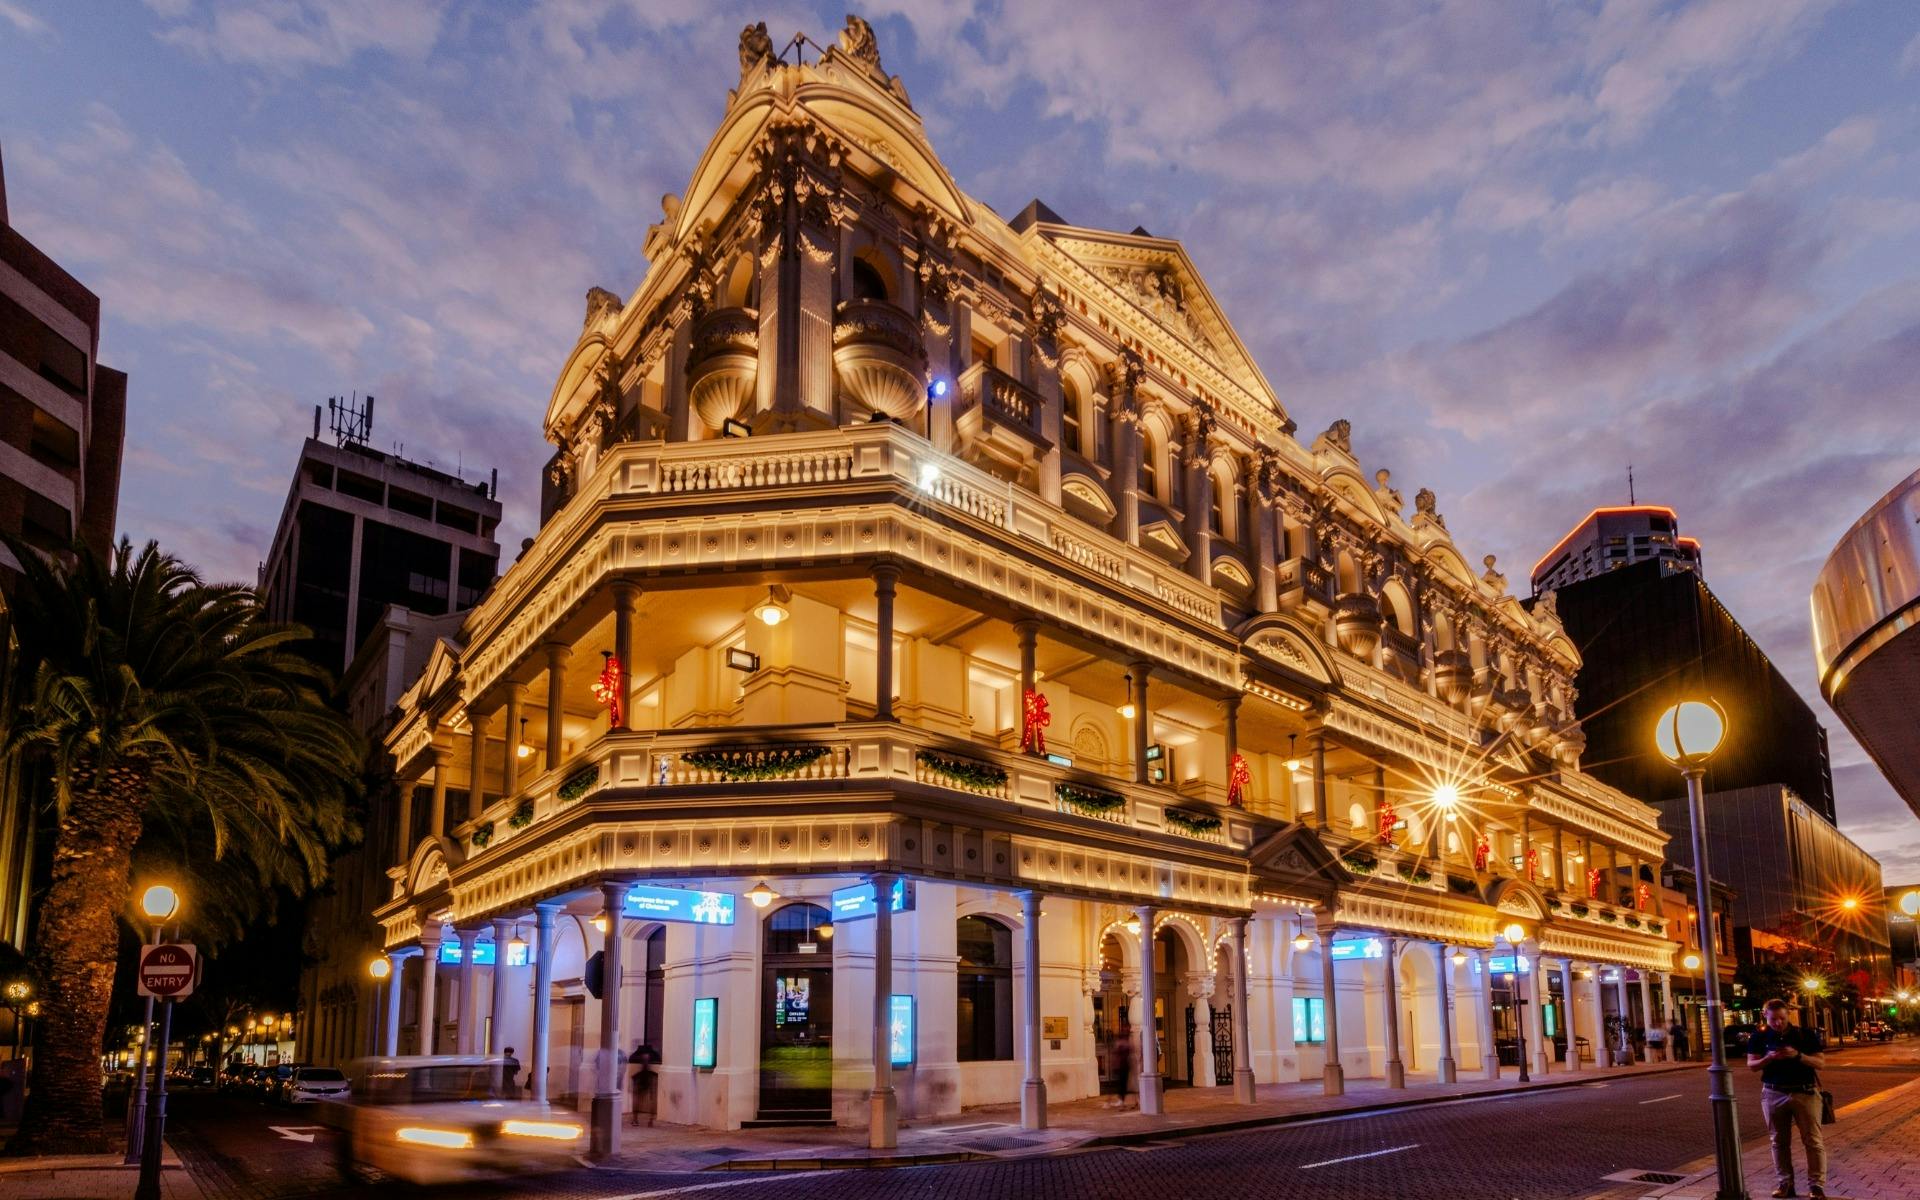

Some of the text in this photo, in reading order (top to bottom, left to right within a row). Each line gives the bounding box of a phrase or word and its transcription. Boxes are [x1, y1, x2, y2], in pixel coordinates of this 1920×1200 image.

[1057, 283, 1088, 317] HIS
[1195, 383, 1257, 438] THEATRE
[160, 953, 176, 963] NO
[147, 976, 184, 987] ENTRY
